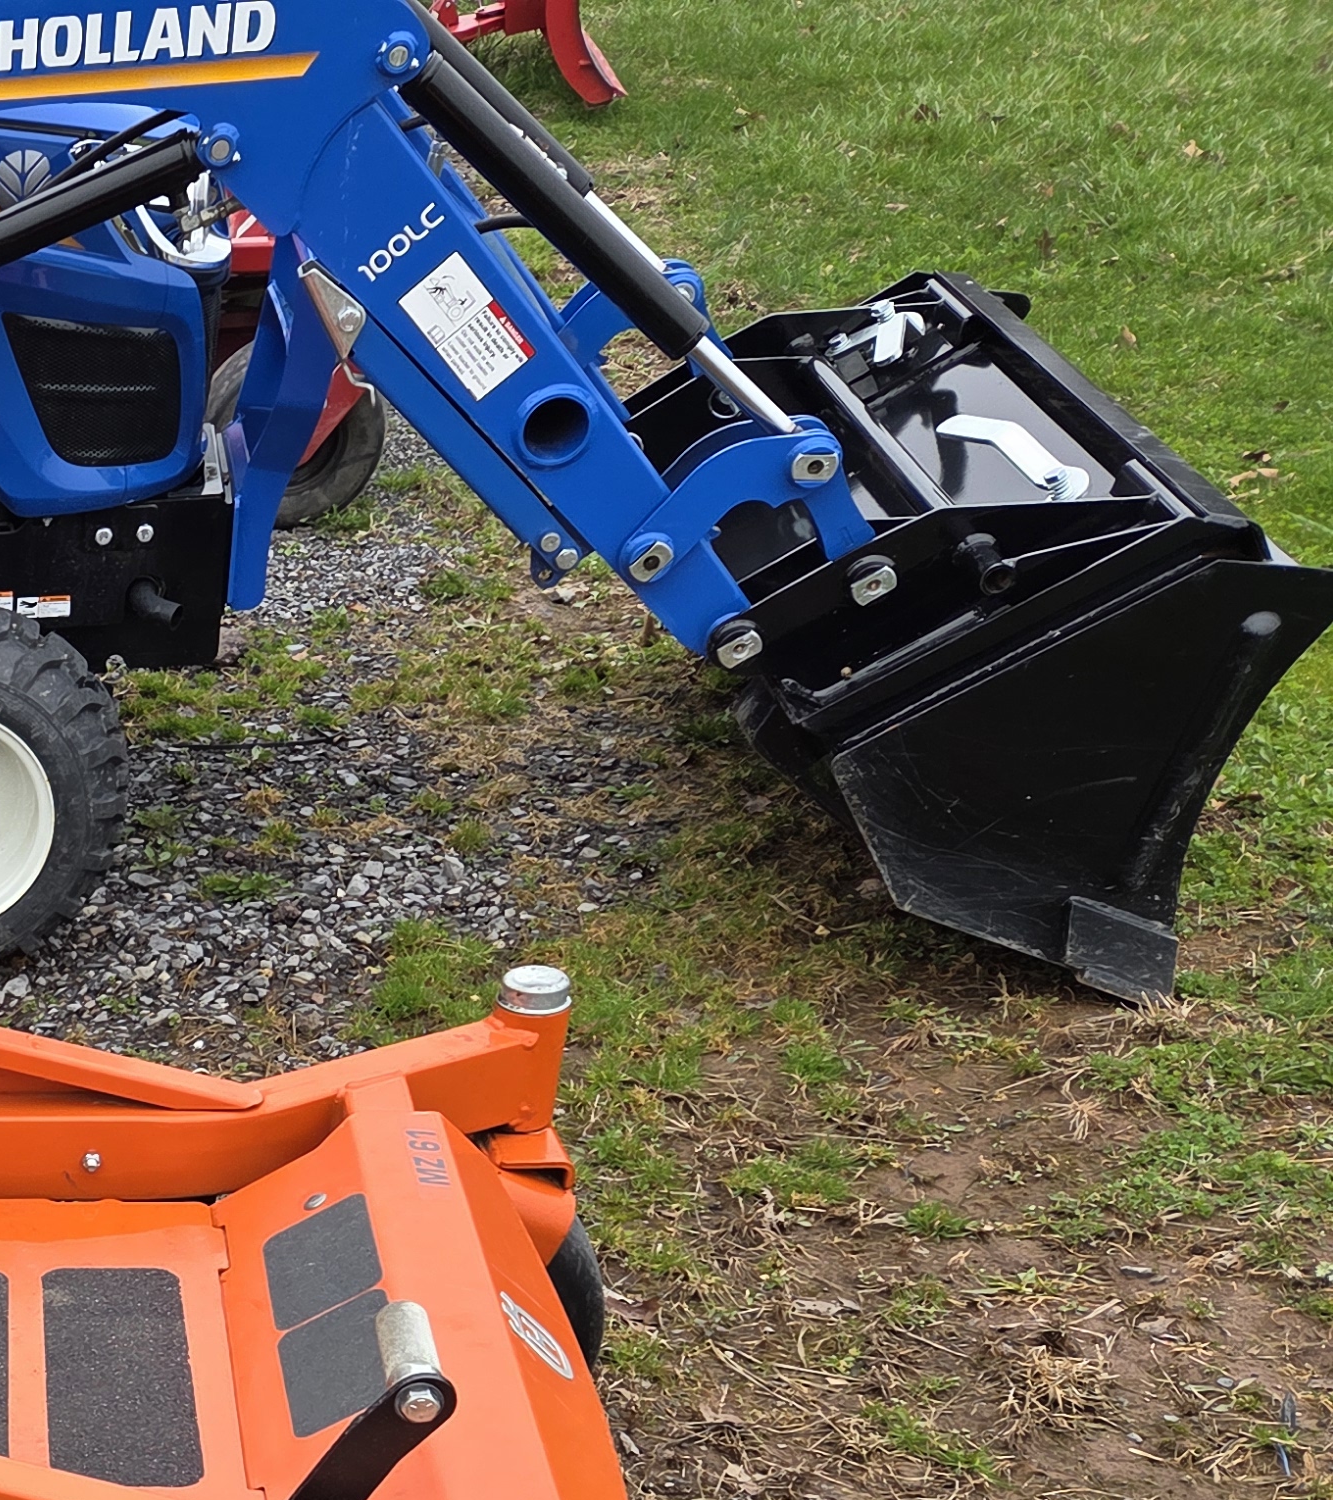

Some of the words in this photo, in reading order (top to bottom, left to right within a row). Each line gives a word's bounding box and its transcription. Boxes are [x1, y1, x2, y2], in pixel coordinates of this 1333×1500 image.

[357, 202, 445, 283] 100LC
[405, 1130, 441, 1152] 61
[413, 1156, 451, 1186] MZ
